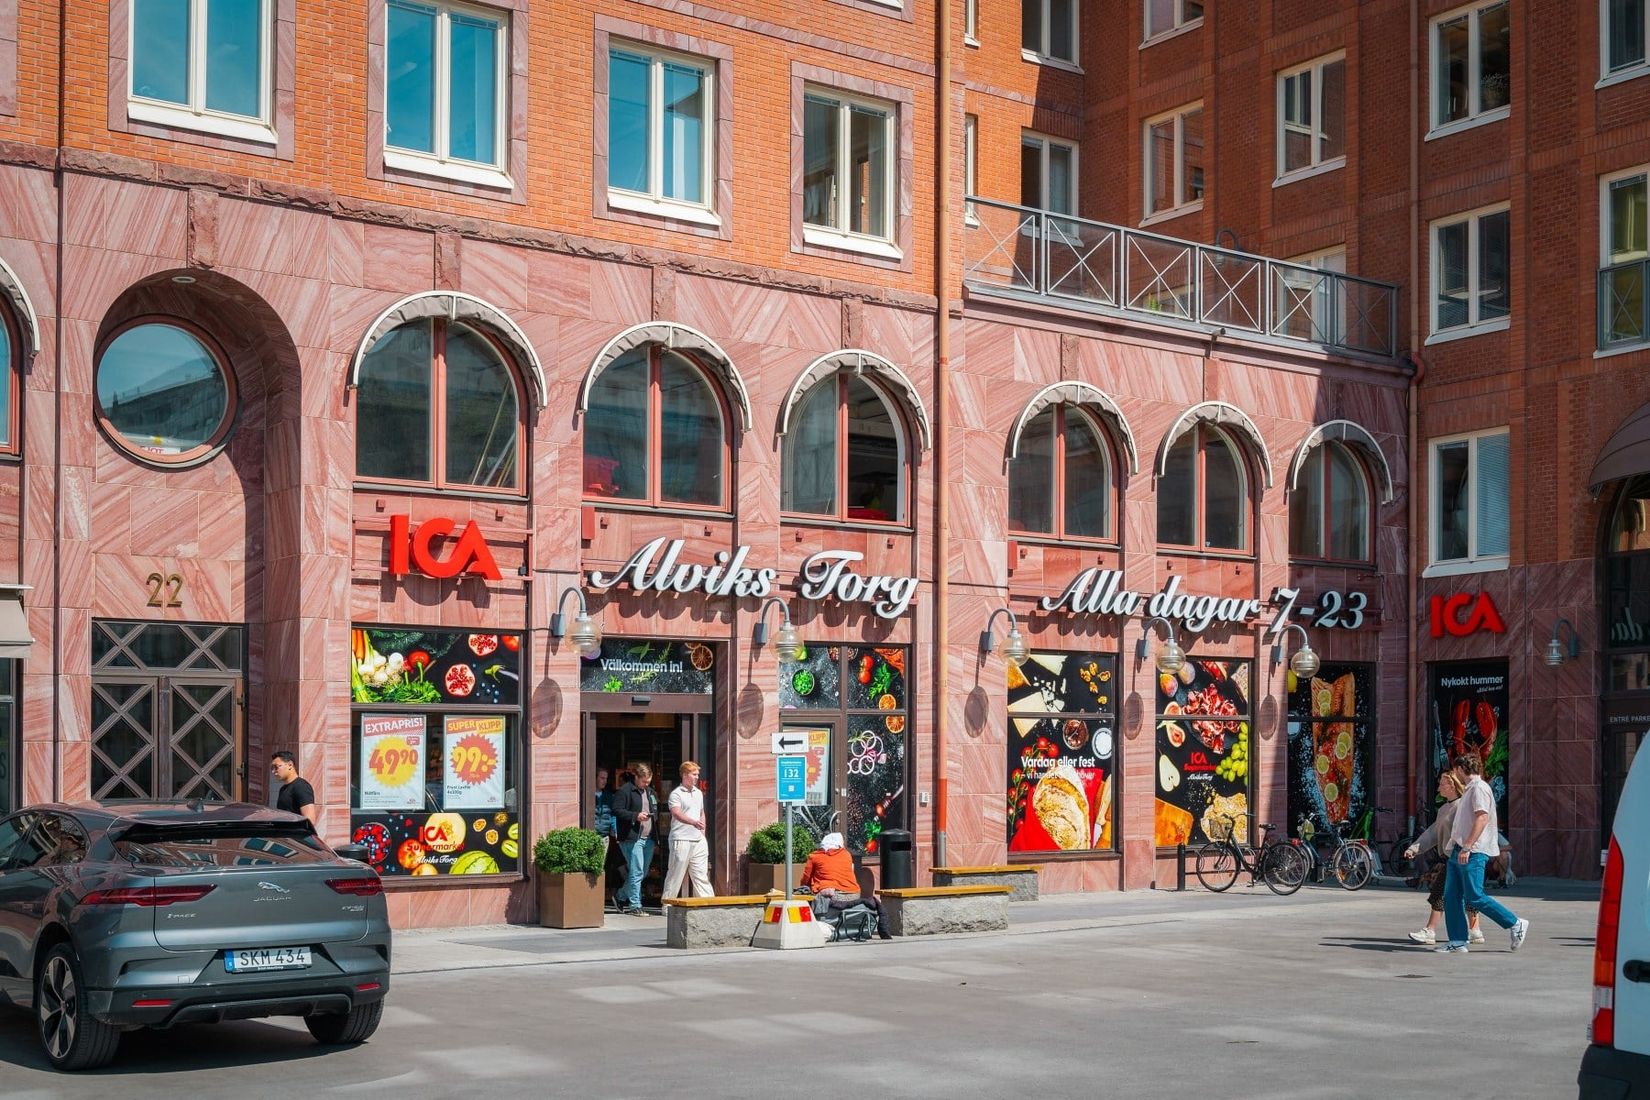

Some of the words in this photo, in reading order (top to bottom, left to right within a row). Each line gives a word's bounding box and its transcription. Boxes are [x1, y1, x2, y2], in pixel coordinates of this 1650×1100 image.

[390, 514, 502, 580] ICA
[590, 536, 776, 599] Alviks
[802, 550, 919, 619] Torg
[145, 572, 183, 607] 22
[1042, 567, 1142, 616] Alla
[1149, 575, 1262, 633] dagar
[1430, 591, 1506, 639] ICA
[601, 658, 667, 673] Välkommen
[670, 661, 683, 673] in!
[1441, 677, 1469, 688] Nykokt
[1470, 675, 1504, 685] hummer
[365, 718, 423, 734] EXTRAPRIS!
[447, 720, 476, 732] SUPER
[478, 719, 501, 731] KLIPP
[1021, 755, 1056, 769] Vardag
[1058, 755, 1077, 767] eller
[1079, 755, 1096, 767] fest
[1191, 751, 1208, 765] ICA
[784, 768, 799, 777] 132
[418, 825, 448, 842] ICA
[240, 951, 271, 967] SKM
[276, 948, 305, 964] 434
